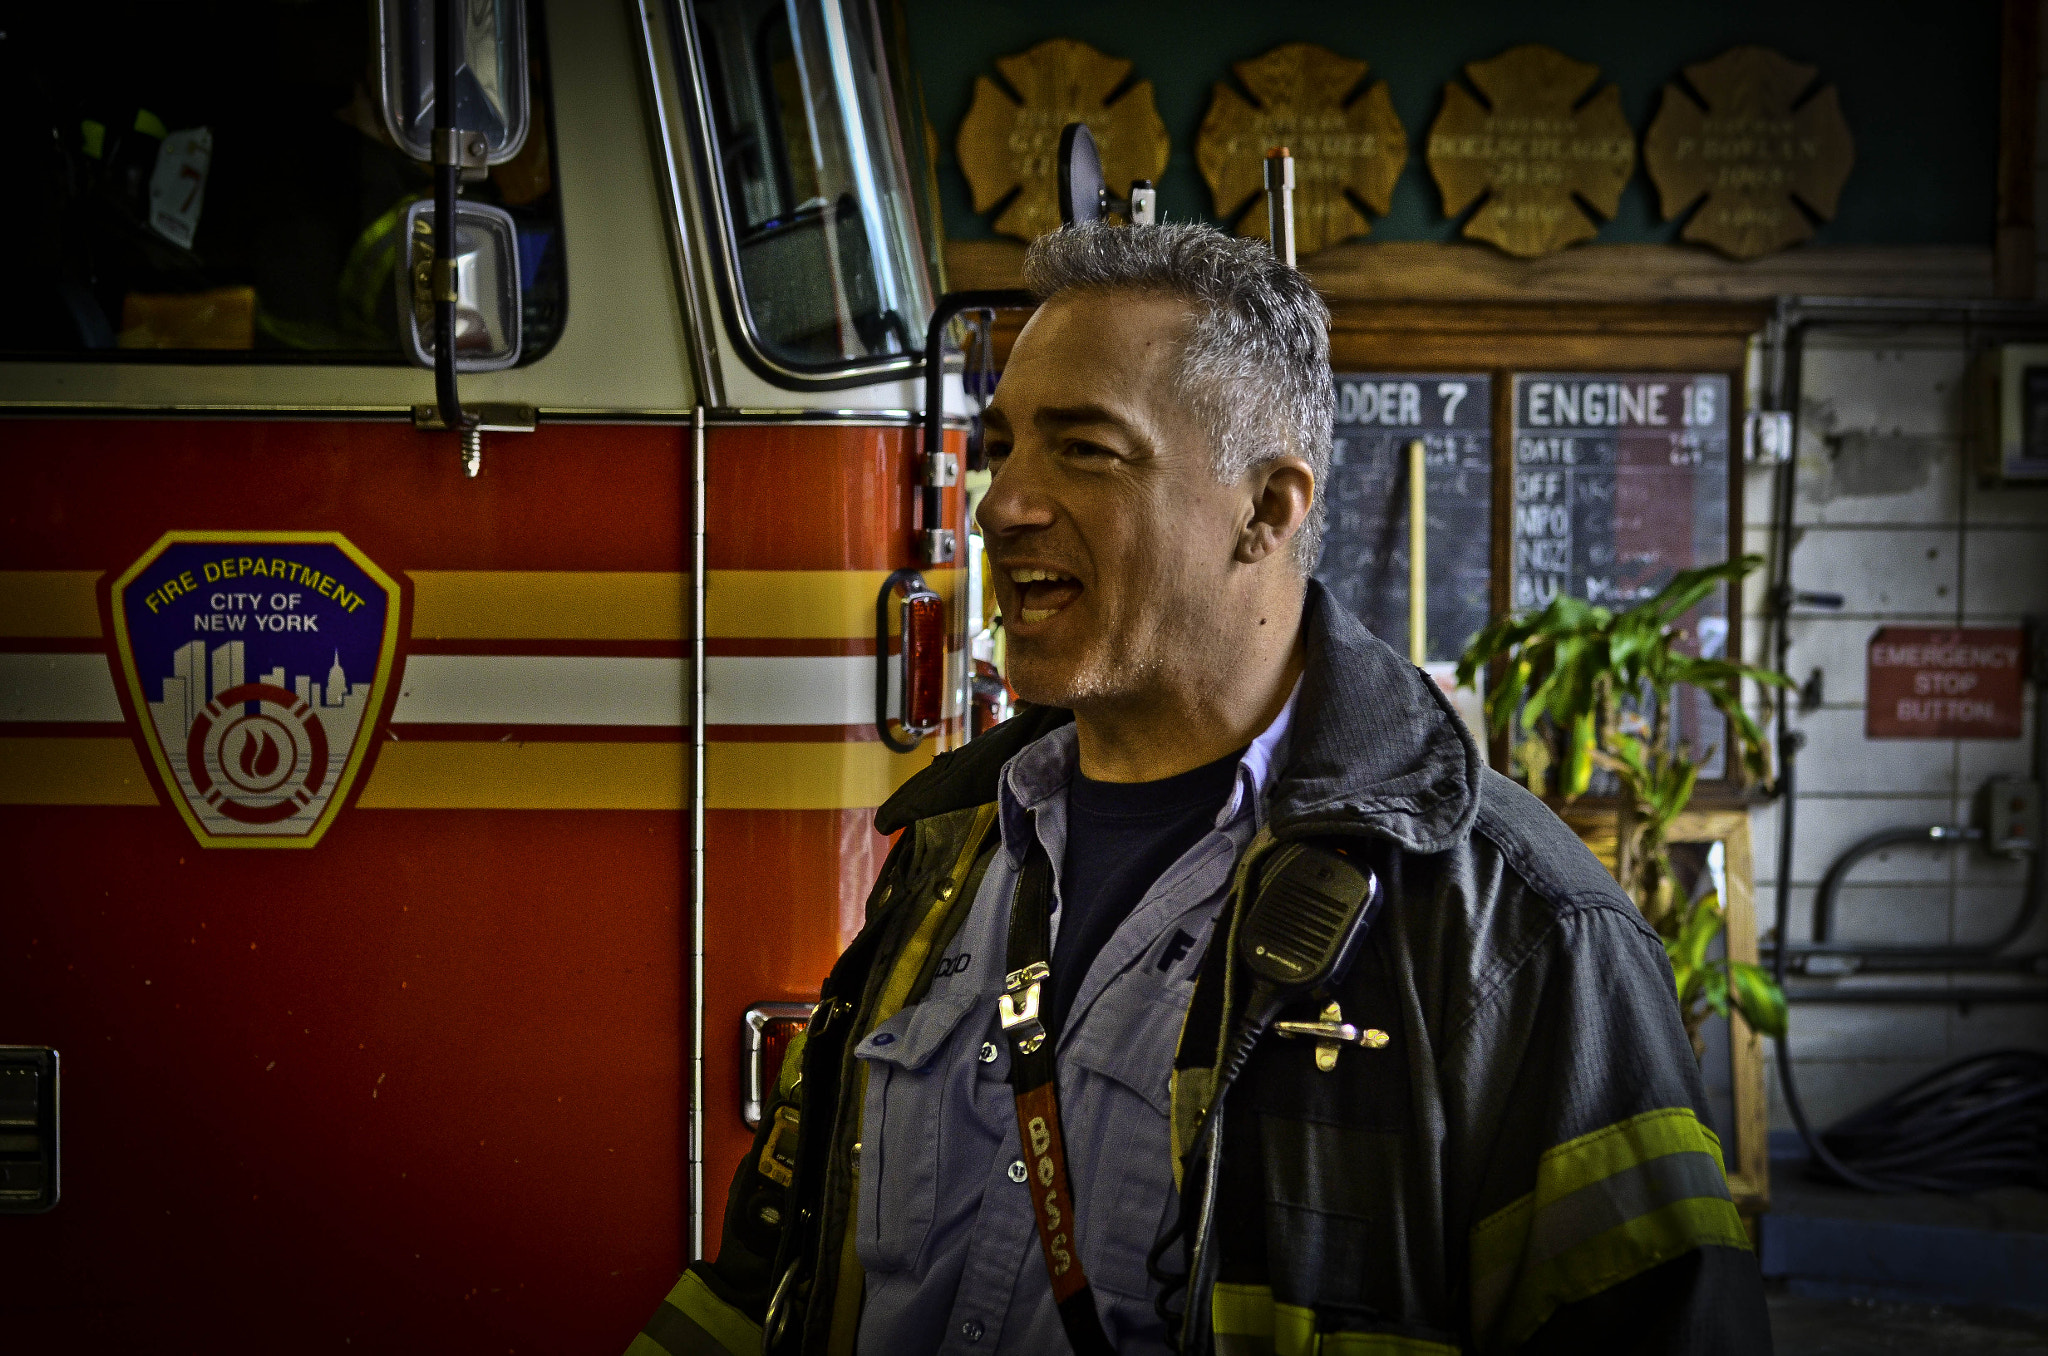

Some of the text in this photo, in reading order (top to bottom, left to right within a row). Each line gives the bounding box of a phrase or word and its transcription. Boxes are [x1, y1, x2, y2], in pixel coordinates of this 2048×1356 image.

[1437, 382, 1468, 426] 7
[1528, 382, 1716, 427] ENGINE 16
[1518, 438, 1577, 465] DATE
[1517, 471, 1560, 500] OFF
[144, 556, 367, 615] FIRE DEPARTMENT
[210, 592, 303, 611] CITY OF
[193, 614, 320, 632] NEW YORK
[1871, 643, 2021, 667] EMERGENCY
[1913, 671, 1980, 695] STOP
[1896, 698, 1995, 721] BUTTON
[1028, 1116, 1071, 1276] BOSS
